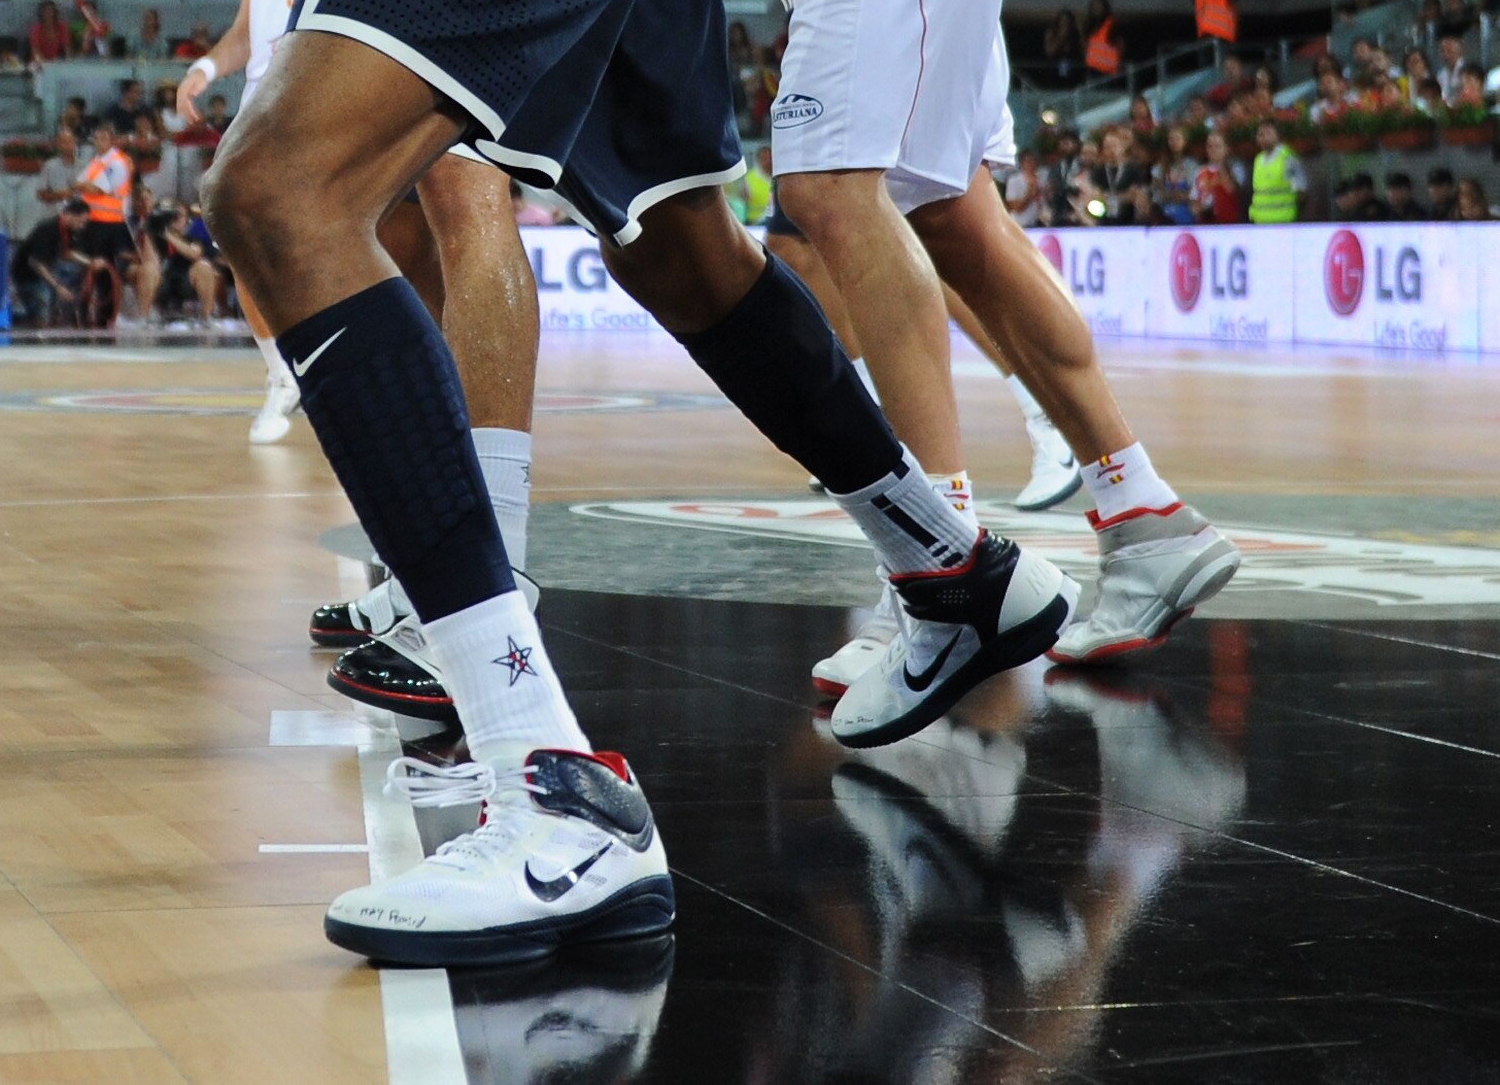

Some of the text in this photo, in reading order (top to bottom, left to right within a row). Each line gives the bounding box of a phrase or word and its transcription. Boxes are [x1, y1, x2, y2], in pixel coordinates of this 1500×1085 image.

[532, 247, 607, 293] LG
[1071, 248, 1105, 295] LG
[1211, 248, 1248, 298] LG
[1375, 247, 1421, 301] LG
